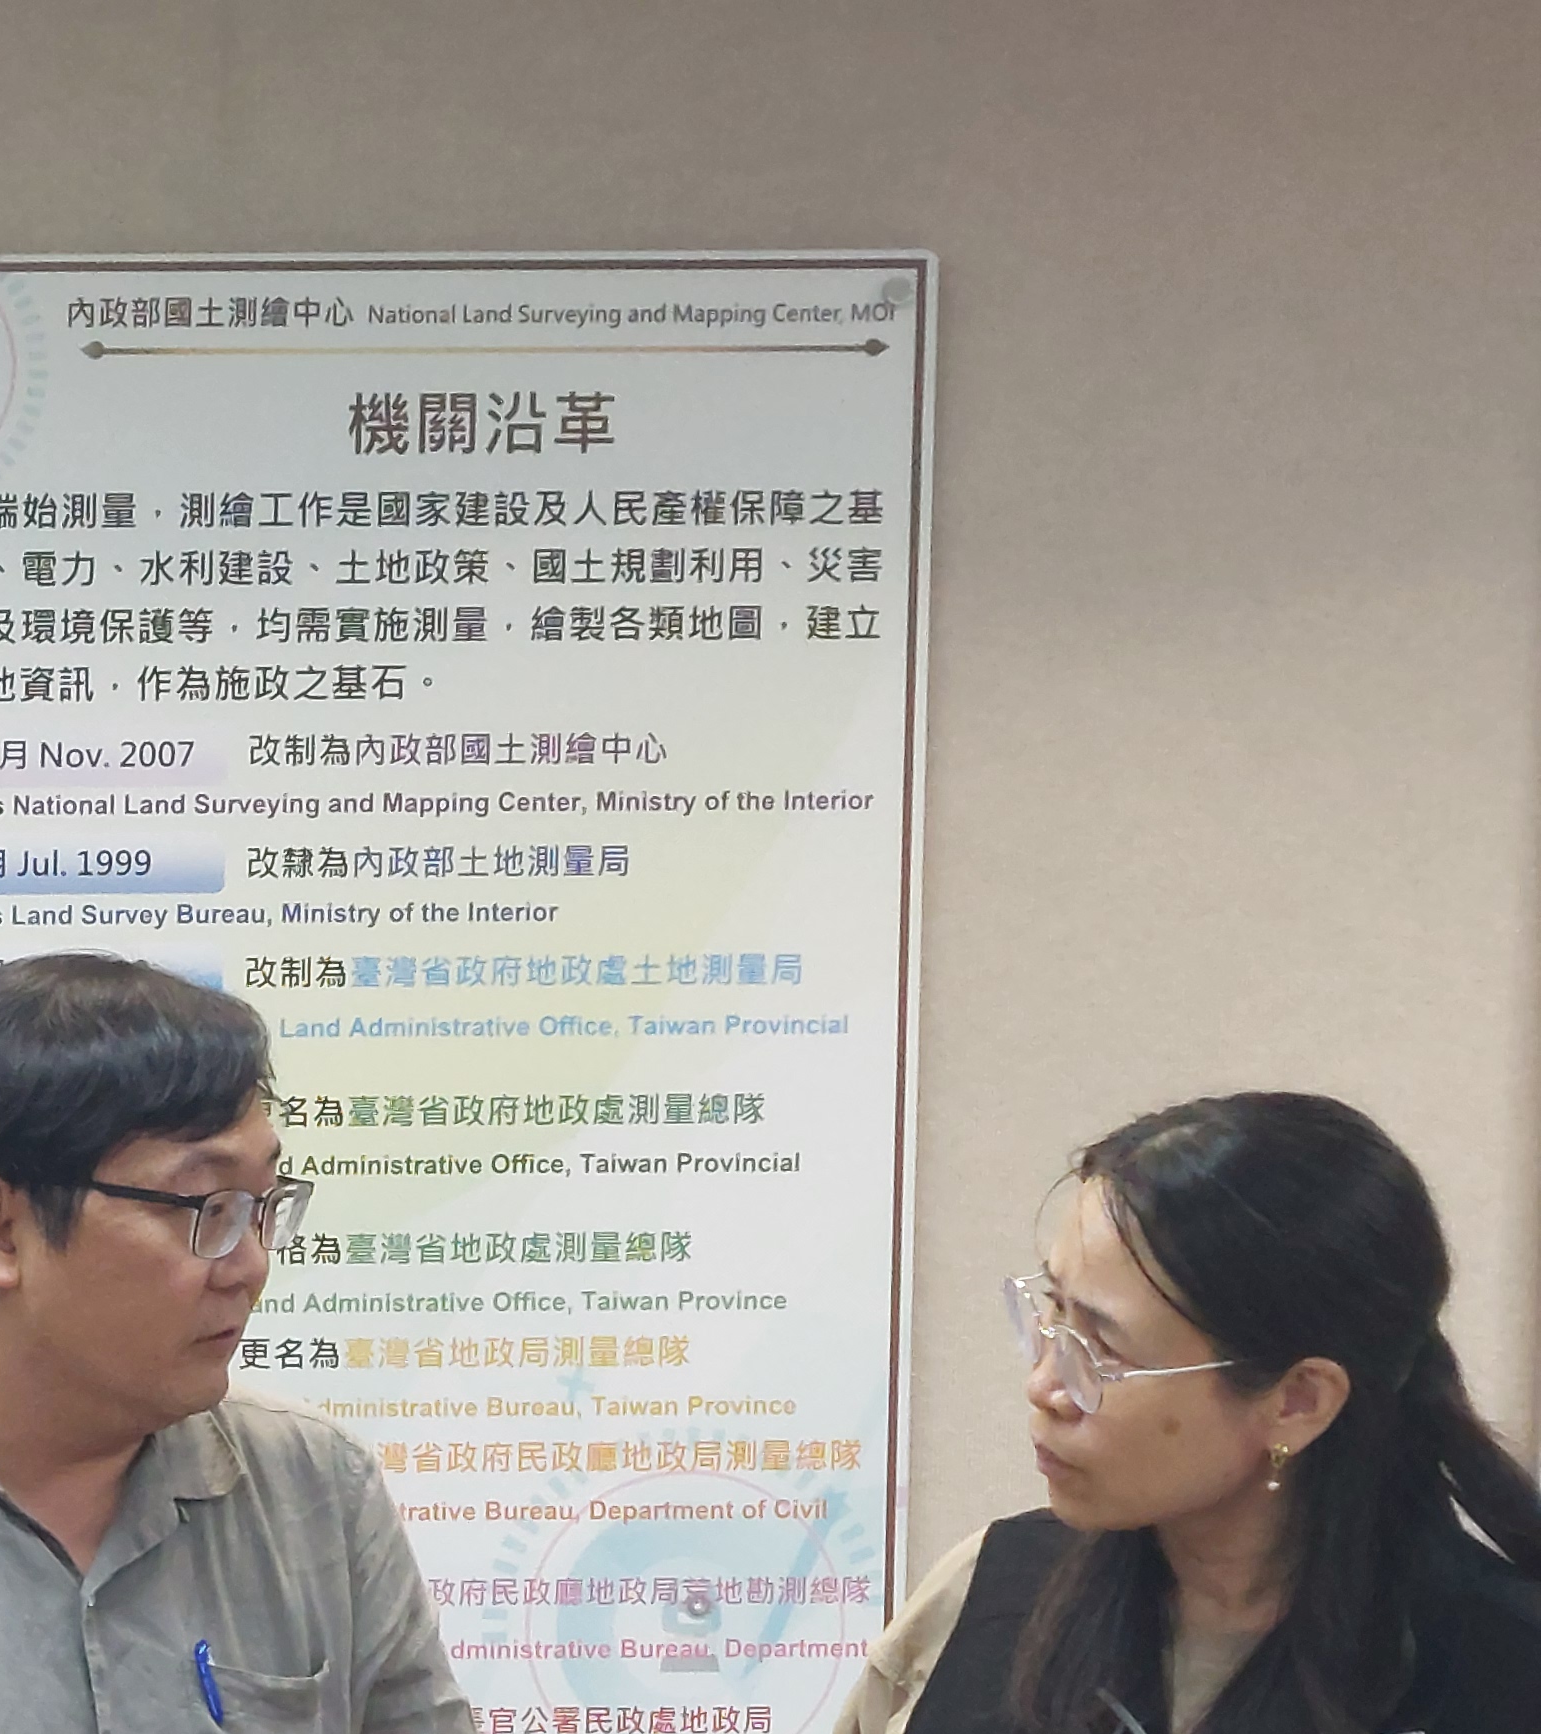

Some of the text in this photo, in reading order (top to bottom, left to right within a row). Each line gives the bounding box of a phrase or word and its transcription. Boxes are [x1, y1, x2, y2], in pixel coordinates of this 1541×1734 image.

[68, 296, 896, 329] 內政部國土測繪中心 National Land Surveying and Mapping Center, MOI
[348, 390, 615, 456] 機關沿革
[40, 741, 110, 768] Nov.
[119, 740, 195, 768] 2007
[249, 731, 667, 767] 改制為內政部國土測繪中心
[13, 793, 115, 816] National
[124, 793, 186, 815] Land
[194, 792, 320, 820] Surveying
[328, 792, 374, 814] and
[382, 792, 490, 818] Mapping
[498, 791, 588, 816] Center,
[596, 790, 697, 817] Ministry
[704, 790, 731, 811] of
[736, 790, 775, 811] the
[784, 789, 874, 811] Interior
[16, 849, 67, 877] Jul.
[77, 849, 152, 877] 1999
[247, 844, 629, 879] 改隸為內政部土地測量局
[11, 904, 73, 926] Land
[81, 904, 168, 930] Survey
[176, 903, 272, 928] Bureau,
[281, 902, 381, 929] Ministry
[389, 901, 415, 923] of
[421, 902, 460, 923] the
[468, 901, 560, 922] Interior
[245, 953, 801, 989] 改制為臺灣省政府地政處土地測量局
[279, 1017, 341, 1038] Land
[348, 1017, 530, 1038] Administrative
[626, 1015, 716, 1036] Taiwan
[724, 1014, 848, 1035] Provincial
[265, 1093, 765, 1128] 名為臺灣省政府地政處測量總隊
[300, 1154, 483, 1176] Administrative
[491, 1153, 571, 1178] Office,
[579, 1153, 667, 1174] Taiwan
[677, 1151, 800, 1174] Provincial
[302, 1292, 485, 1314] Administrative
[492, 1291, 572, 1316] Office,
[580, 1290, 669, 1312] Taiwan
[678, 1290, 787, 1312] Province
[316, 1395, 796, 1418] dministrative Bureau, Taiwan Province
[485, 1501, 580, 1523] Bureau,
[589, 1500, 734, 1526] Department
[741, 1499, 768, 1520] of
[773, 1498, 829, 1519] Civil
[450, 1639, 611, 1660] dministrative
[725, 1638, 868, 1663] Department
